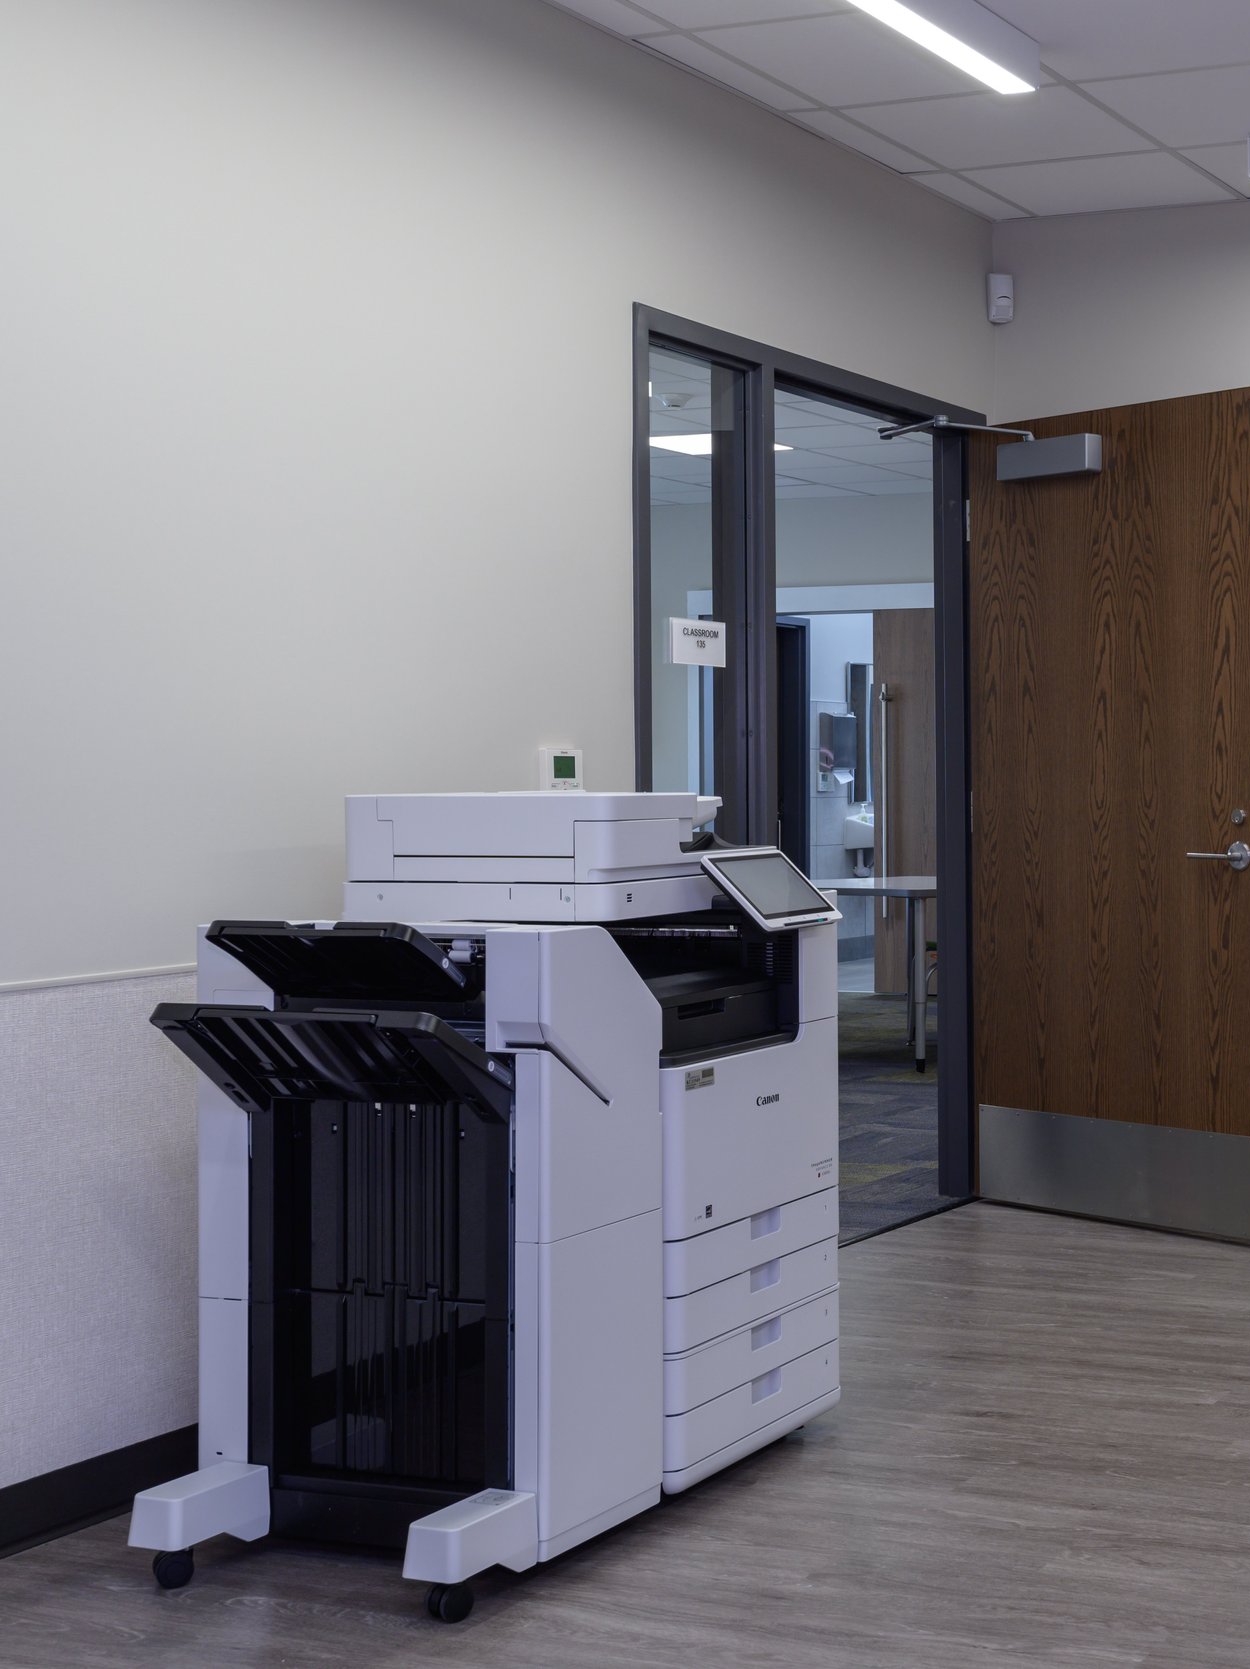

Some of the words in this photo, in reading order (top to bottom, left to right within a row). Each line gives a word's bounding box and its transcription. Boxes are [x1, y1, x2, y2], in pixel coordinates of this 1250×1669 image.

[682, 627, 719, 638] CLASSROOM
[696, 640, 706, 648] 135
[756, 1093, 779, 1106] Canon
